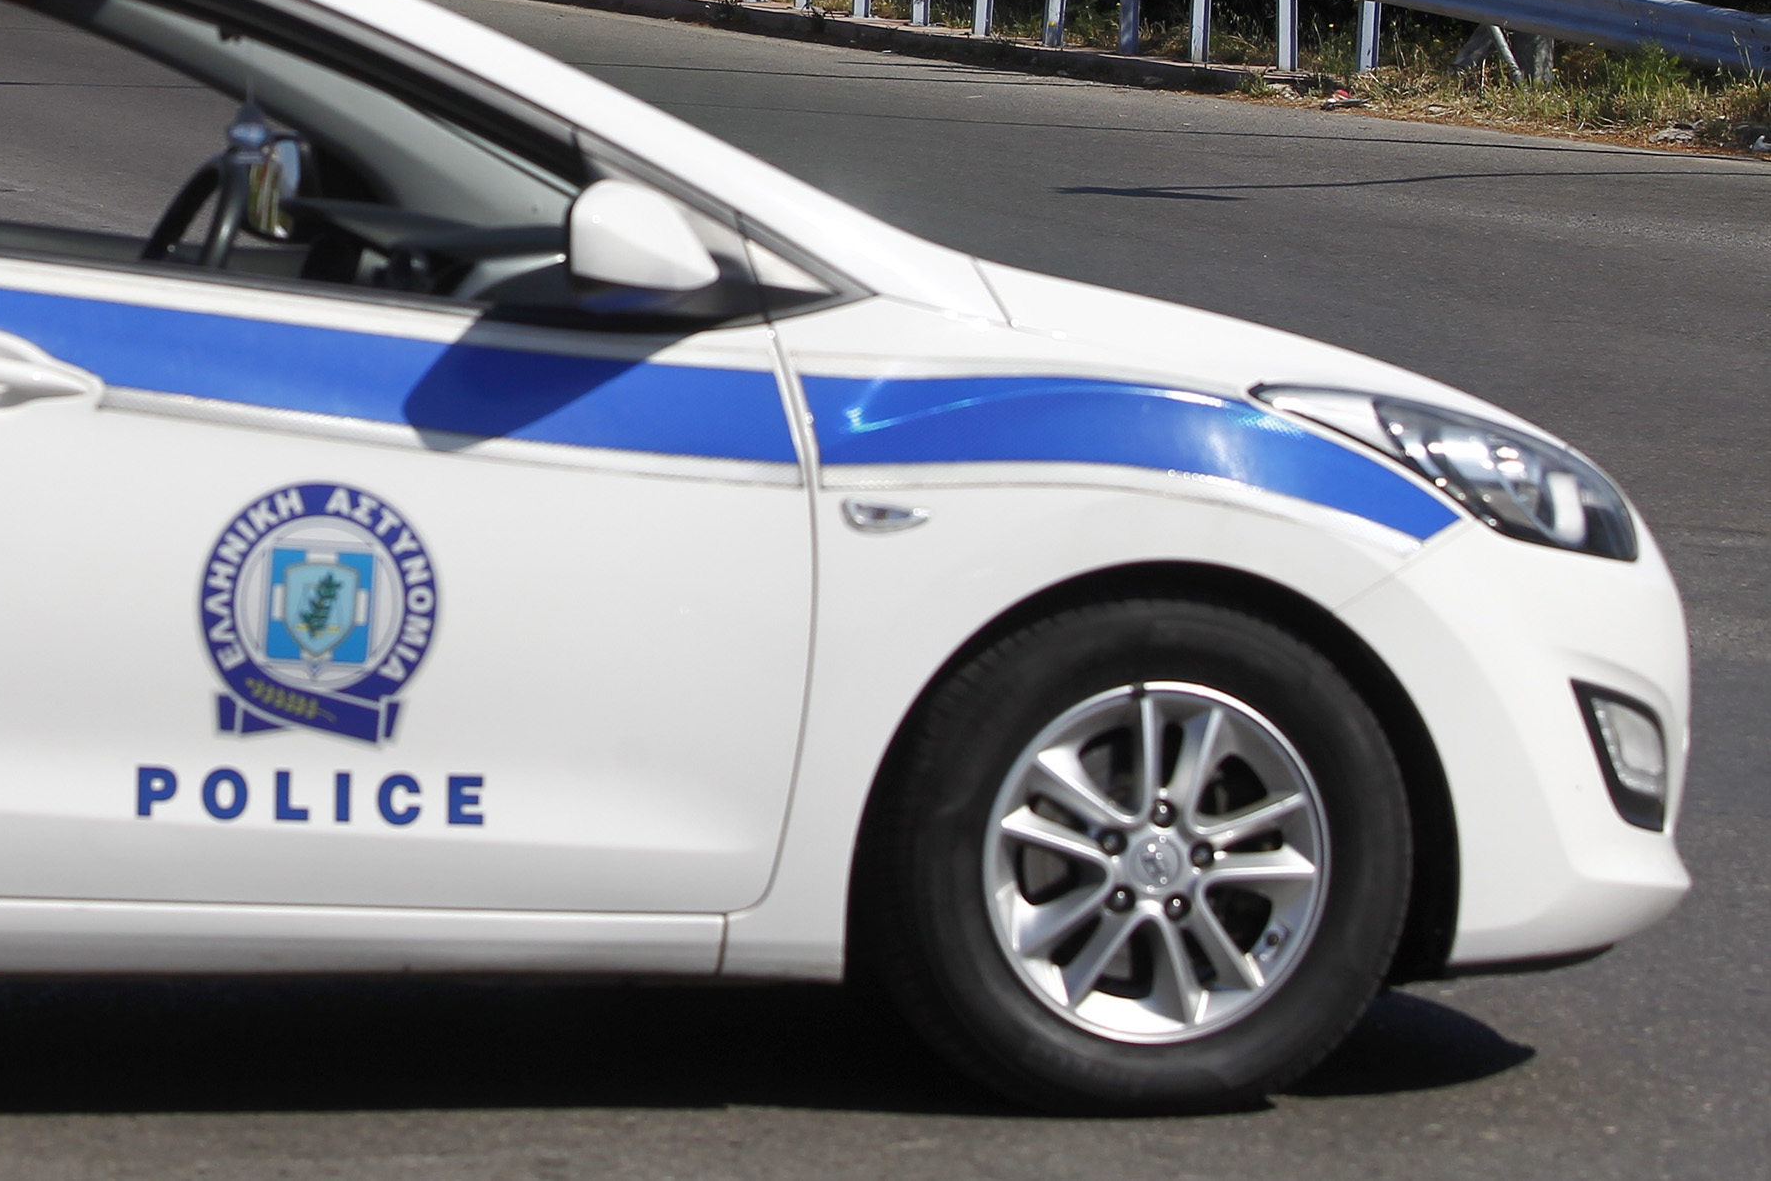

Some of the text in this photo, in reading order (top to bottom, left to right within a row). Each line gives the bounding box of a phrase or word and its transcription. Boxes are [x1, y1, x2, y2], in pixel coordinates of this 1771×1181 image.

[203, 487, 436, 682] ΕΛΛΗΝΙΚΗ ΑΣΤΥΝΟΜΙΑ
[137, 766, 485, 826] POLICE
